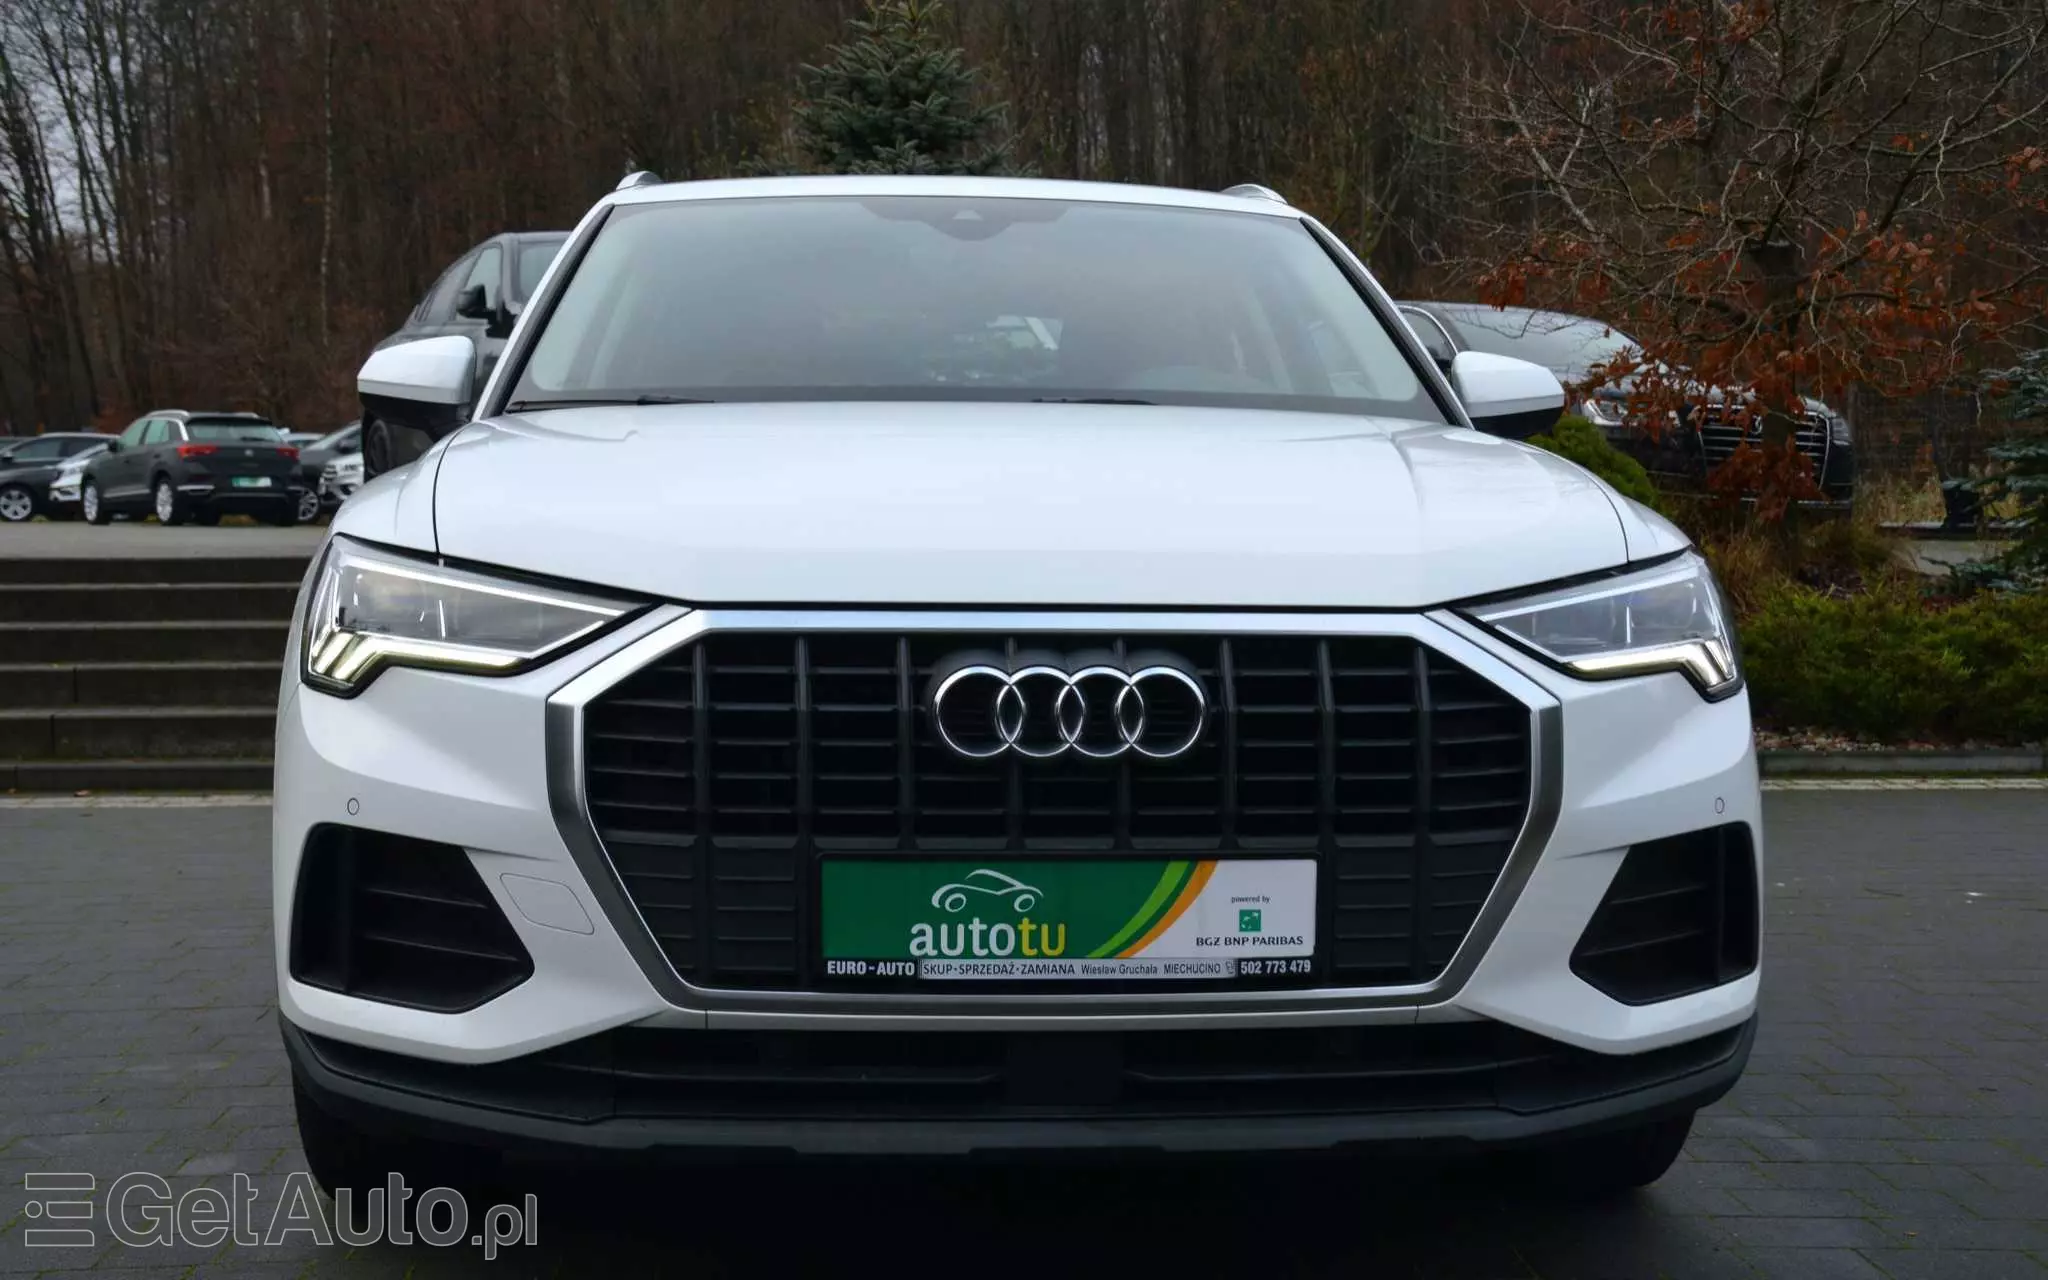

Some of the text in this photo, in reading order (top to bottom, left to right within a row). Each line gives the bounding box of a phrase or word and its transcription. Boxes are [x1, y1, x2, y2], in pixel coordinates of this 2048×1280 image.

[1231, 895, 1270, 904] powered by
[909, 917, 1065, 956] autotu
[1224, 936, 1249, 946] BNP
[1252, 935, 1304, 945] PARIBAS
[1163, 963, 1221, 974] MIECHUCINO
[1240, 961, 1262, 973] 502
[1266, 960, 1286, 973] 773
[1289, 959, 1311, 972] 479
